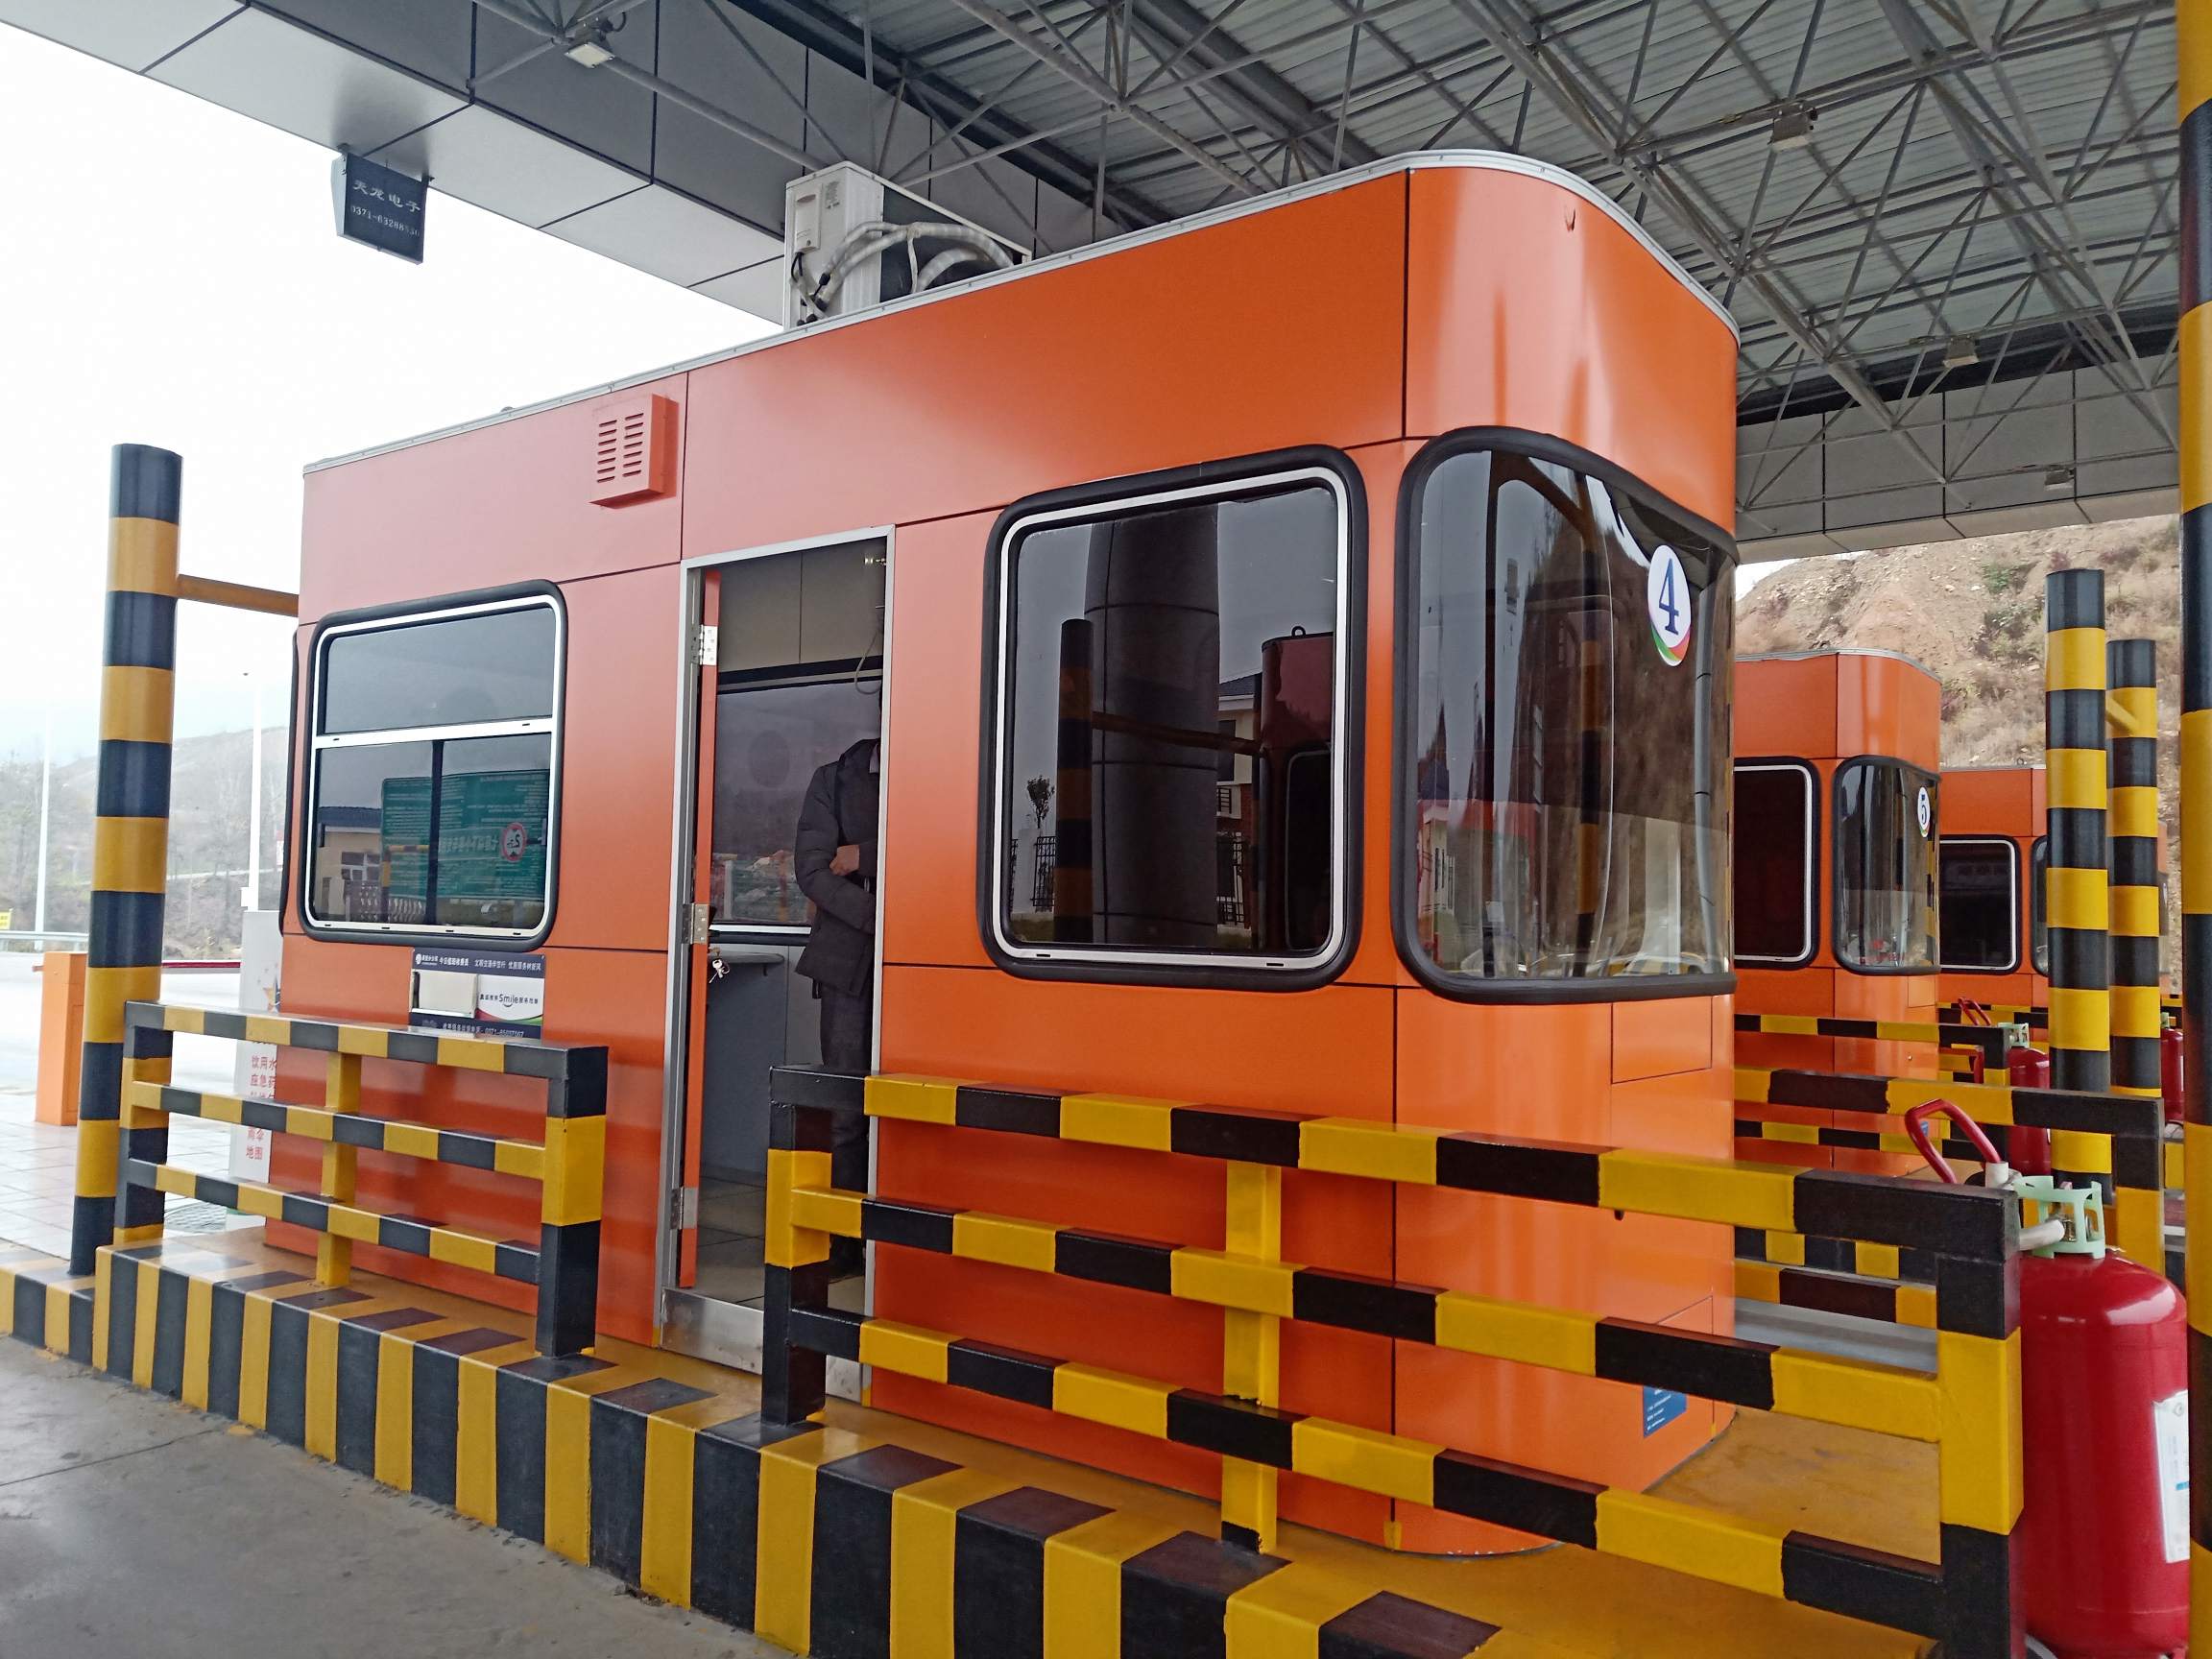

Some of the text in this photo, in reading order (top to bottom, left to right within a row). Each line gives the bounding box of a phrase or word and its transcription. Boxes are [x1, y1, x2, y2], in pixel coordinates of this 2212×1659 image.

[1659, 558, 1679, 635] 4
[1921, 794, 1927, 825] 5
[498, 994, 519, 1004] Smile
